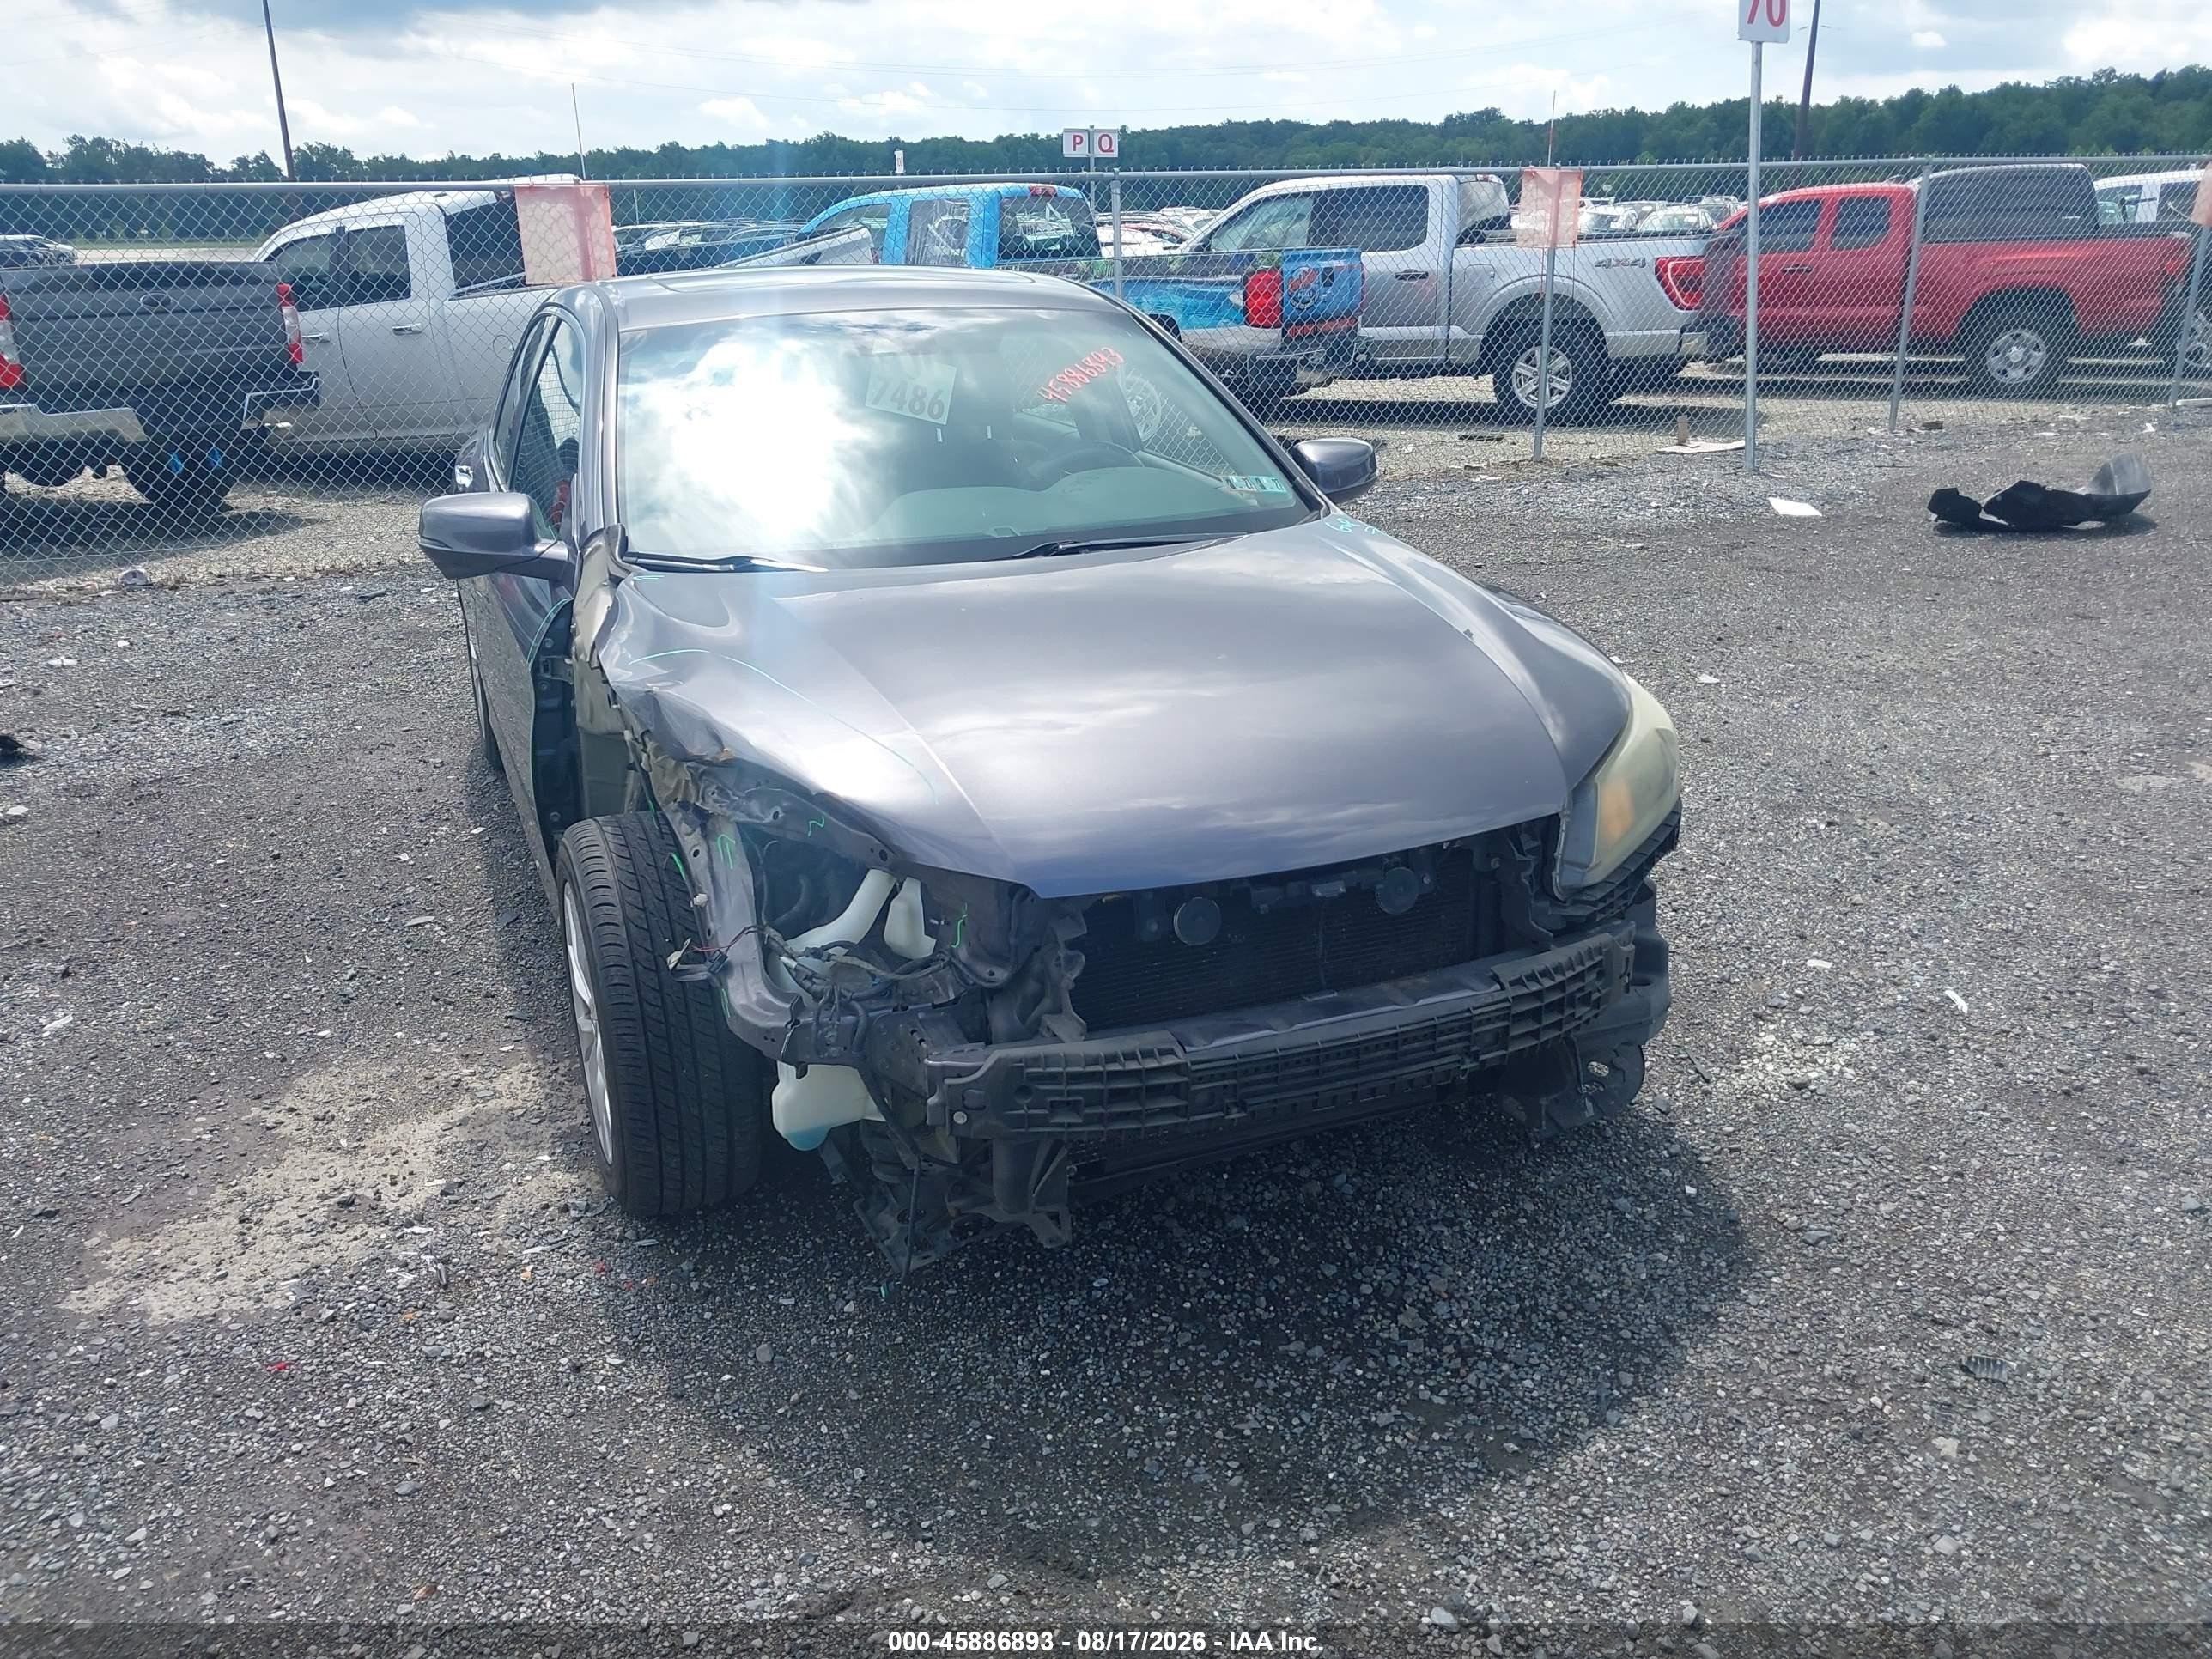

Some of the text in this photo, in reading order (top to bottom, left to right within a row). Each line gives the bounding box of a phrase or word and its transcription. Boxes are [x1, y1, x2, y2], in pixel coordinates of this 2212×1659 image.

[1072, 134, 1084, 152] P
[1097, 133, 1114, 153] Q
[1036, 347, 1125, 403] 45886893
[871, 379, 945, 420] 7486
